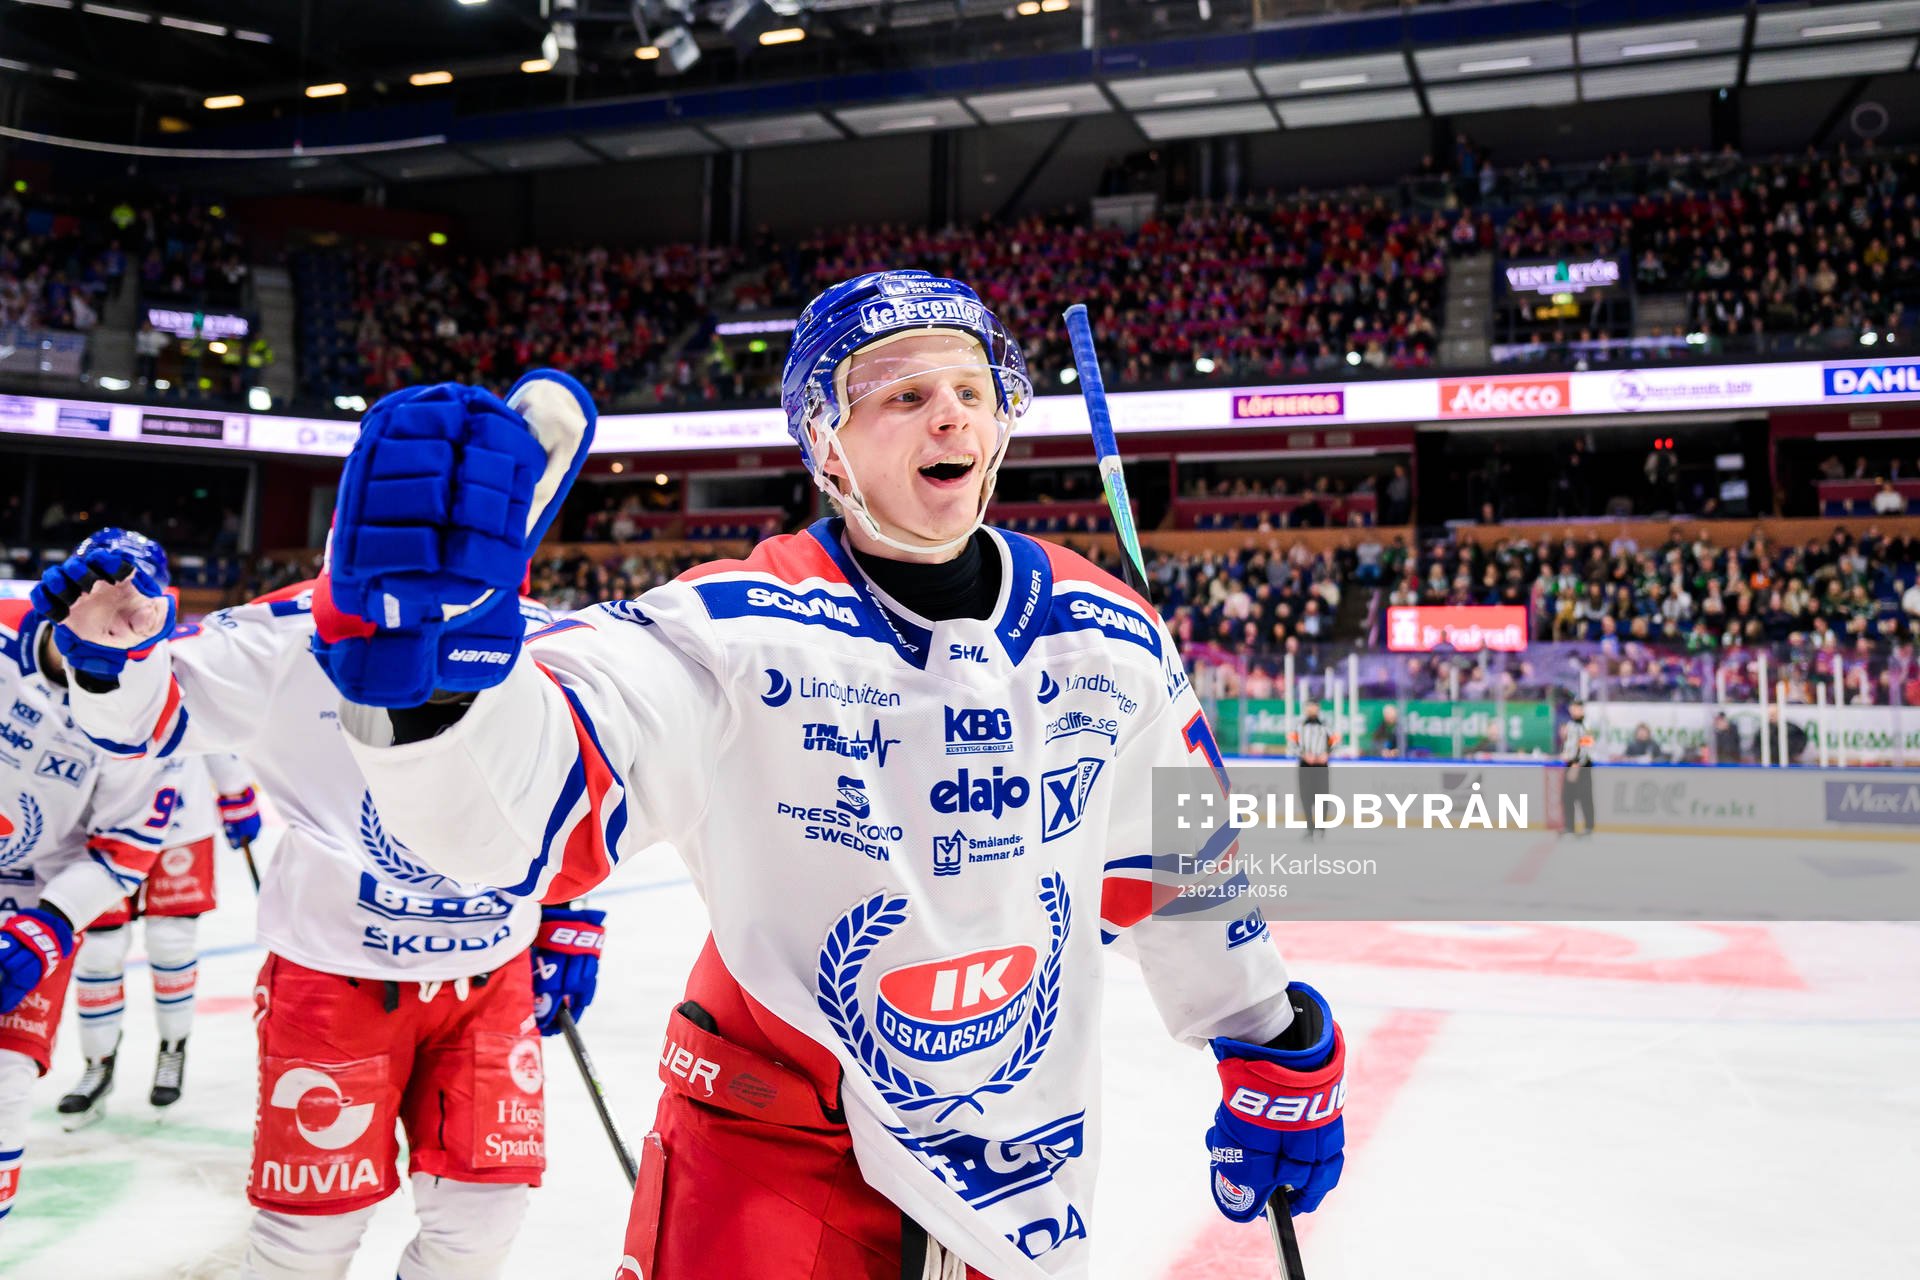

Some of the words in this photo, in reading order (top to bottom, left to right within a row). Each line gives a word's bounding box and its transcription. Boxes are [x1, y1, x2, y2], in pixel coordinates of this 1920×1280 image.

[1449, 383, 1561, 412] Adecco
[747, 587, 860, 627] SCANIA
[1069, 599, 1154, 646] SCANIA
[950, 643, 989, 663] SHL
[943, 704, 1012, 742] KBG
[43, 756, 80, 781] XL
[929, 766, 1030, 820] elajo
[777, 802, 851, 828] PRESS
[805, 826, 889, 861] SWEDEN
[968, 850, 1011, 863] hamnar
[1013, 846, 1025, 858] AB
[969, 834, 1024, 850] Smålands-
[931, 955, 1015, 1011] IK
[883, 988, 1031, 1055] OSKARSHAMN
